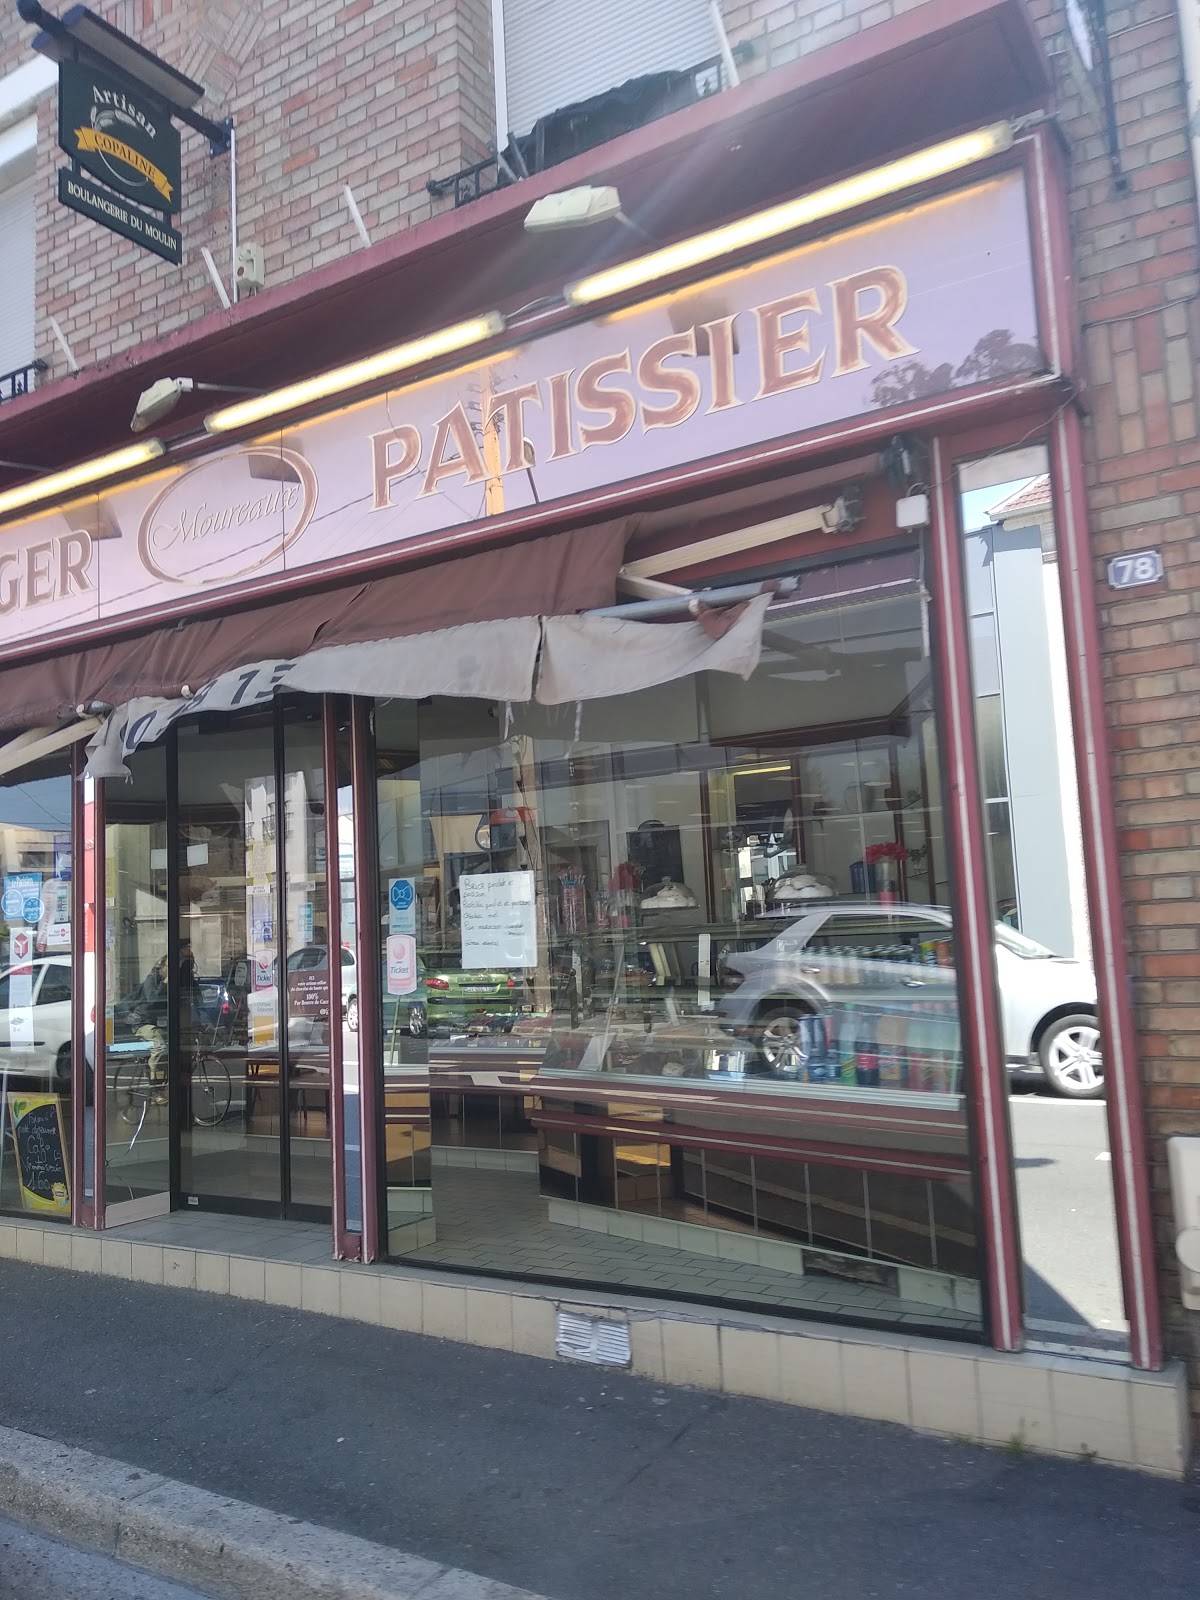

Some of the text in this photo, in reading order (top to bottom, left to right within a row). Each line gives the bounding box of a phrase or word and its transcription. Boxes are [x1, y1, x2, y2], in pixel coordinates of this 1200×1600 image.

[93, 85, 157, 139] Artisan
[94, 134, 157, 181] COPALINE
[67, 180, 178, 252] BOULANGERIE DU MOULIN
[368, 265, 921, 512] PATISSIER
[152, 484, 301, 551] Moureaux
[1115, 557, 1155, 584] 78
[390, 966, 409, 974] Ticket
[306, 992, 319, 1000] 100%
